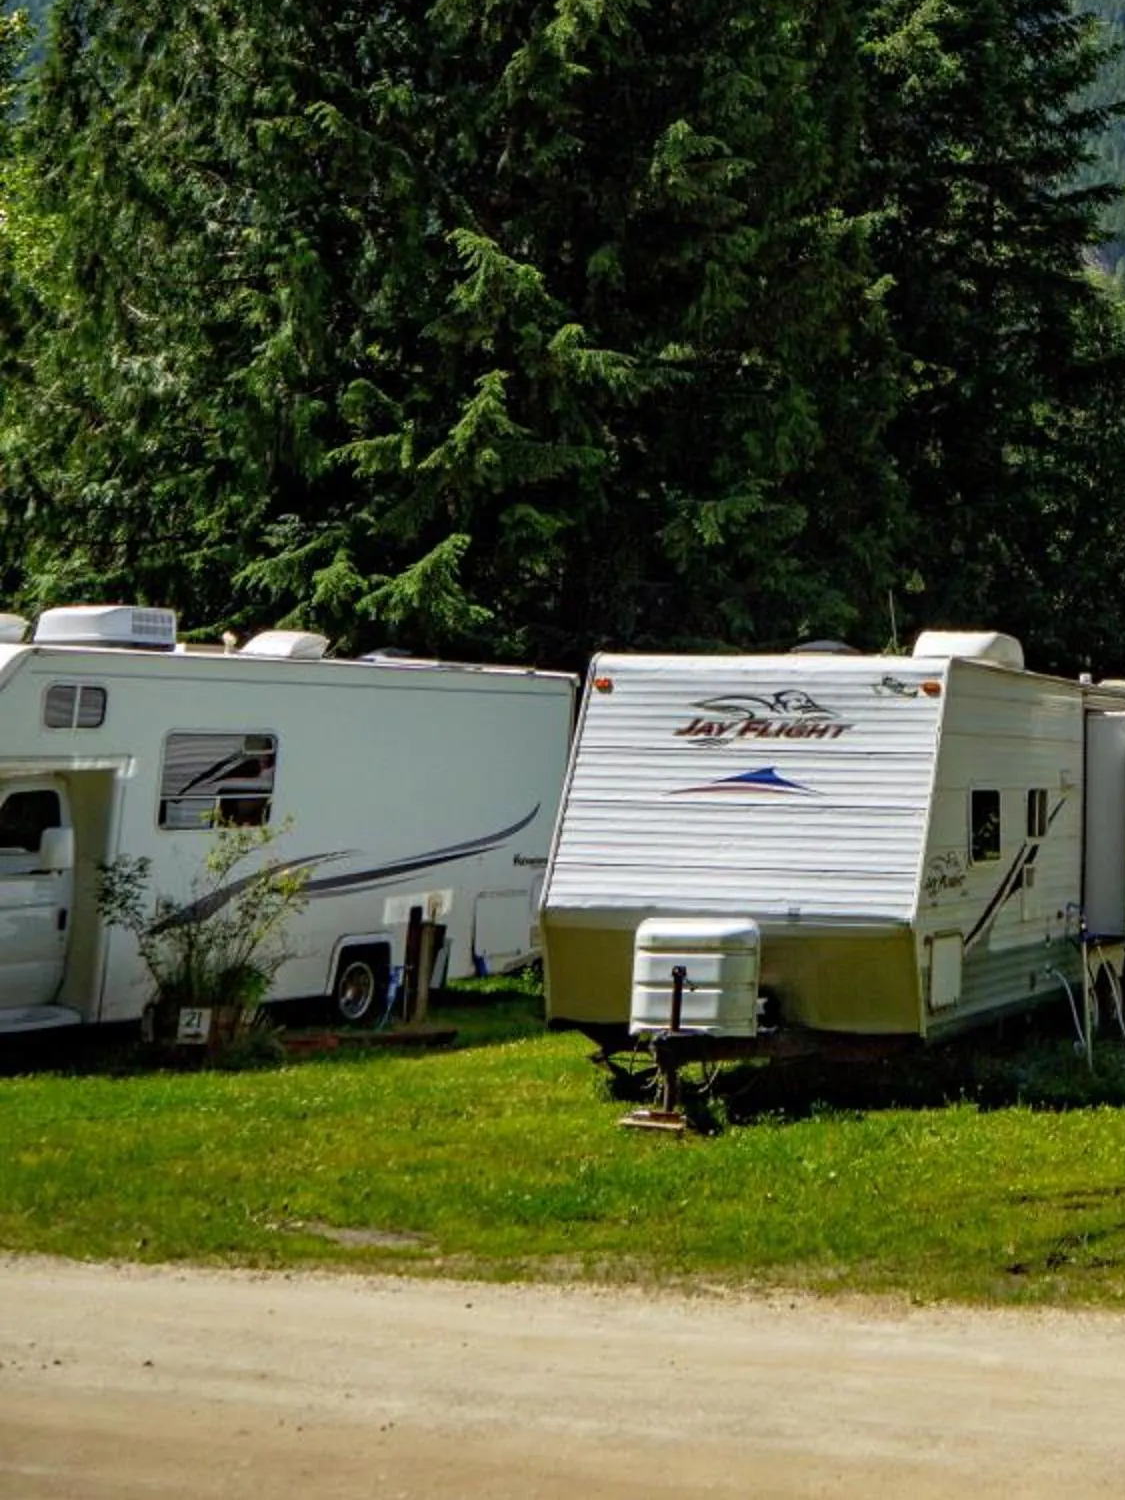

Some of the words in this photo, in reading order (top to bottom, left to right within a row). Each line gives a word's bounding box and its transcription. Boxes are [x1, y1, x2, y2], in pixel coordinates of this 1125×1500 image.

[673, 717, 737, 737] JAY
[735, 718, 855, 739] FLIGHT
[185, 1011, 203, 1029] 21
